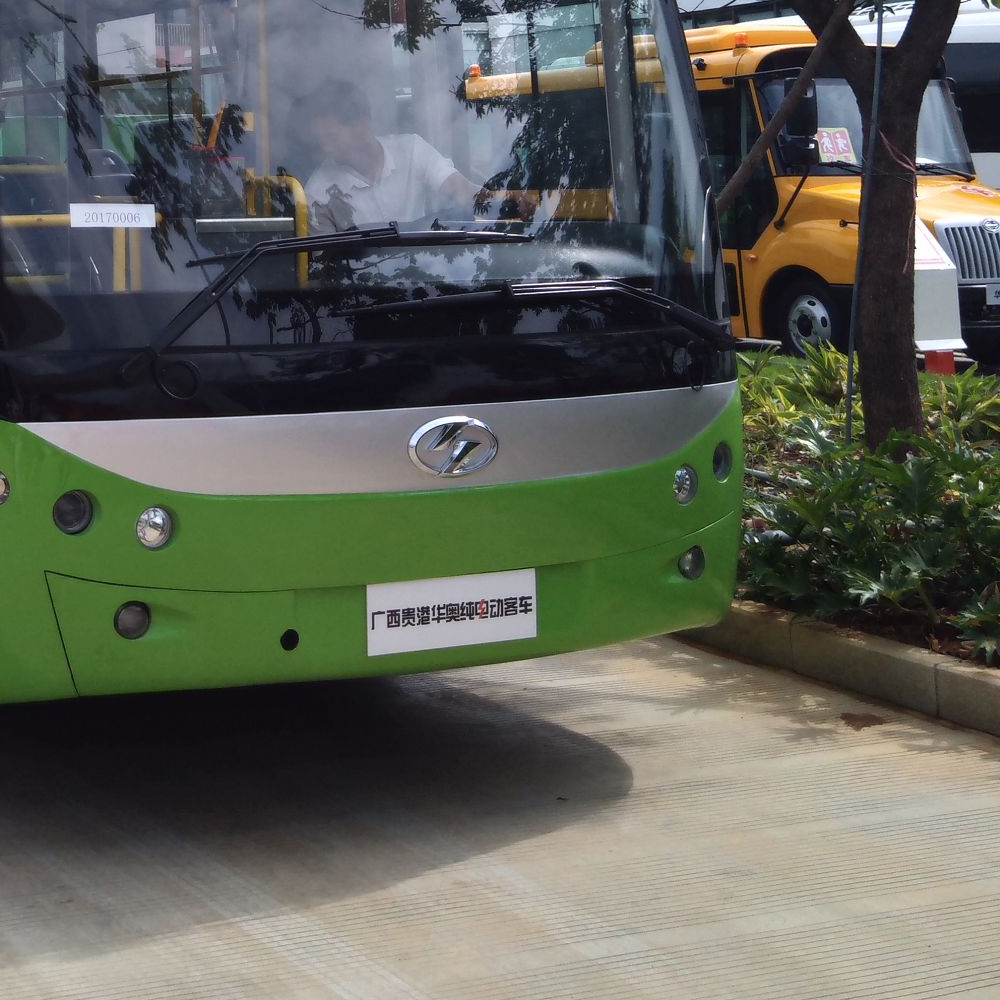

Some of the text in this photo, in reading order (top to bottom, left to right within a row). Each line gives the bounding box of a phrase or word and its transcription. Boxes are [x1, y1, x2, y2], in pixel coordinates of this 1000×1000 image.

[84, 211, 141, 224] 20170006
[371, 595, 533, 630] 广西贵港华奥纯电动客车
